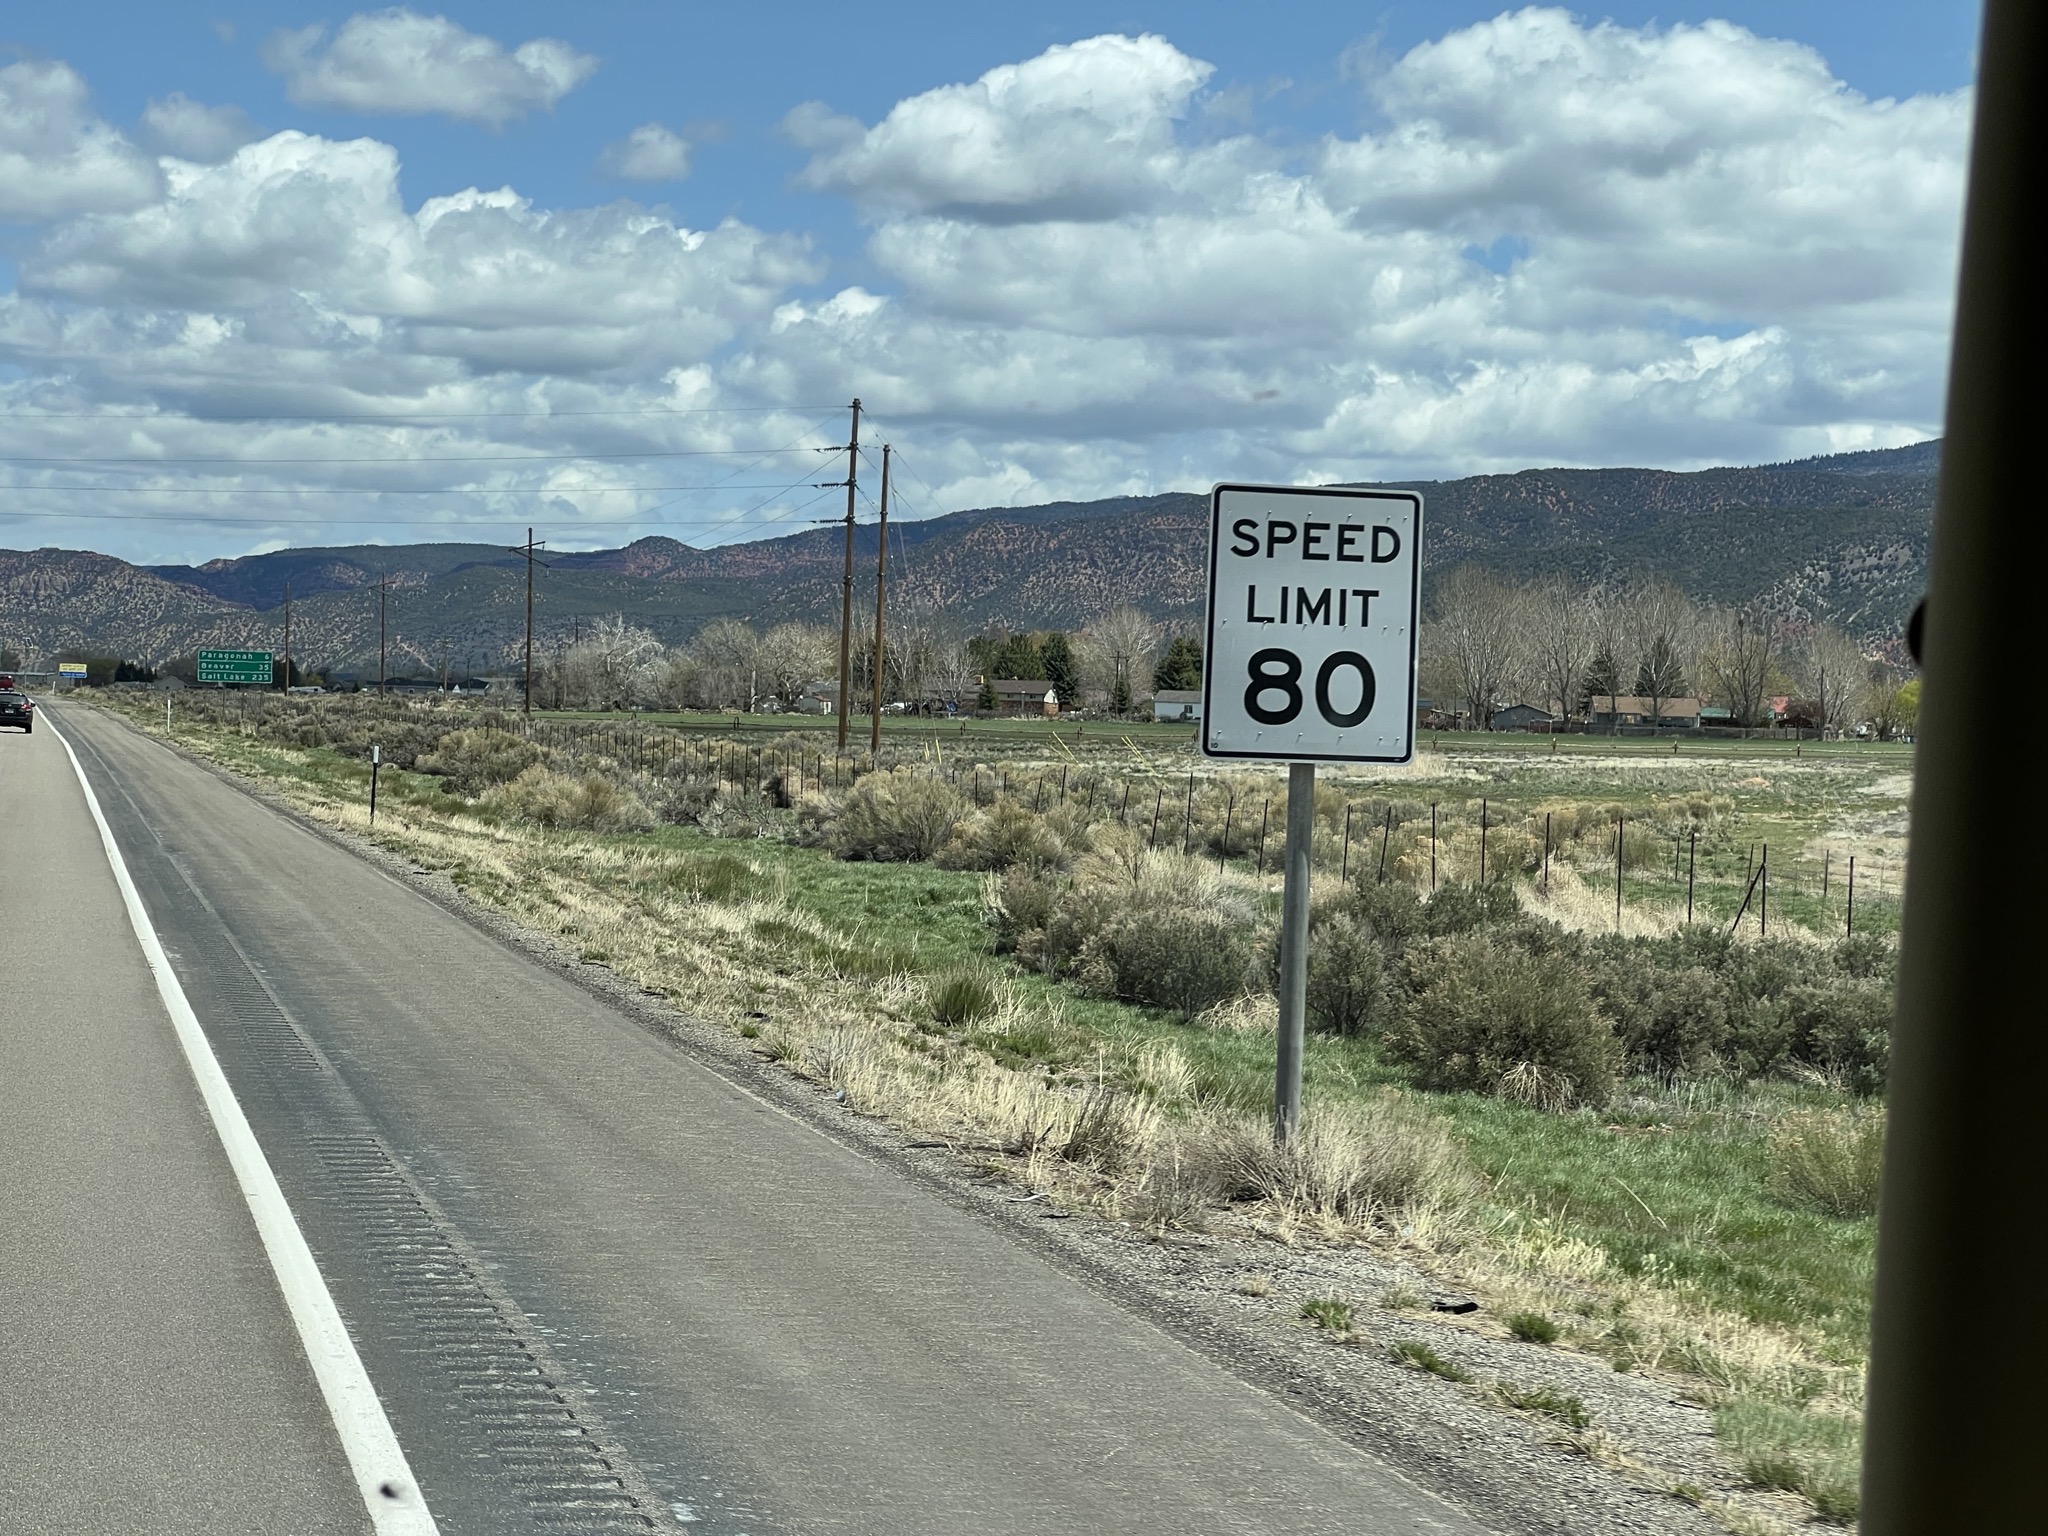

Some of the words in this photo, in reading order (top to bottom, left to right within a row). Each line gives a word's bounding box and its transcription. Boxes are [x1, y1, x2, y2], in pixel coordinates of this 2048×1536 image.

[1231, 518, 1401, 564] SPEED
[1247, 584, 1380, 628] LIMIT
[201, 651, 253, 661] Paragonah
[201, 662, 235, 670] Beaver
[201, 672, 220, 680] Salt
[223, 673, 245, 681] Lake
[1243, 647, 1376, 728] 80
